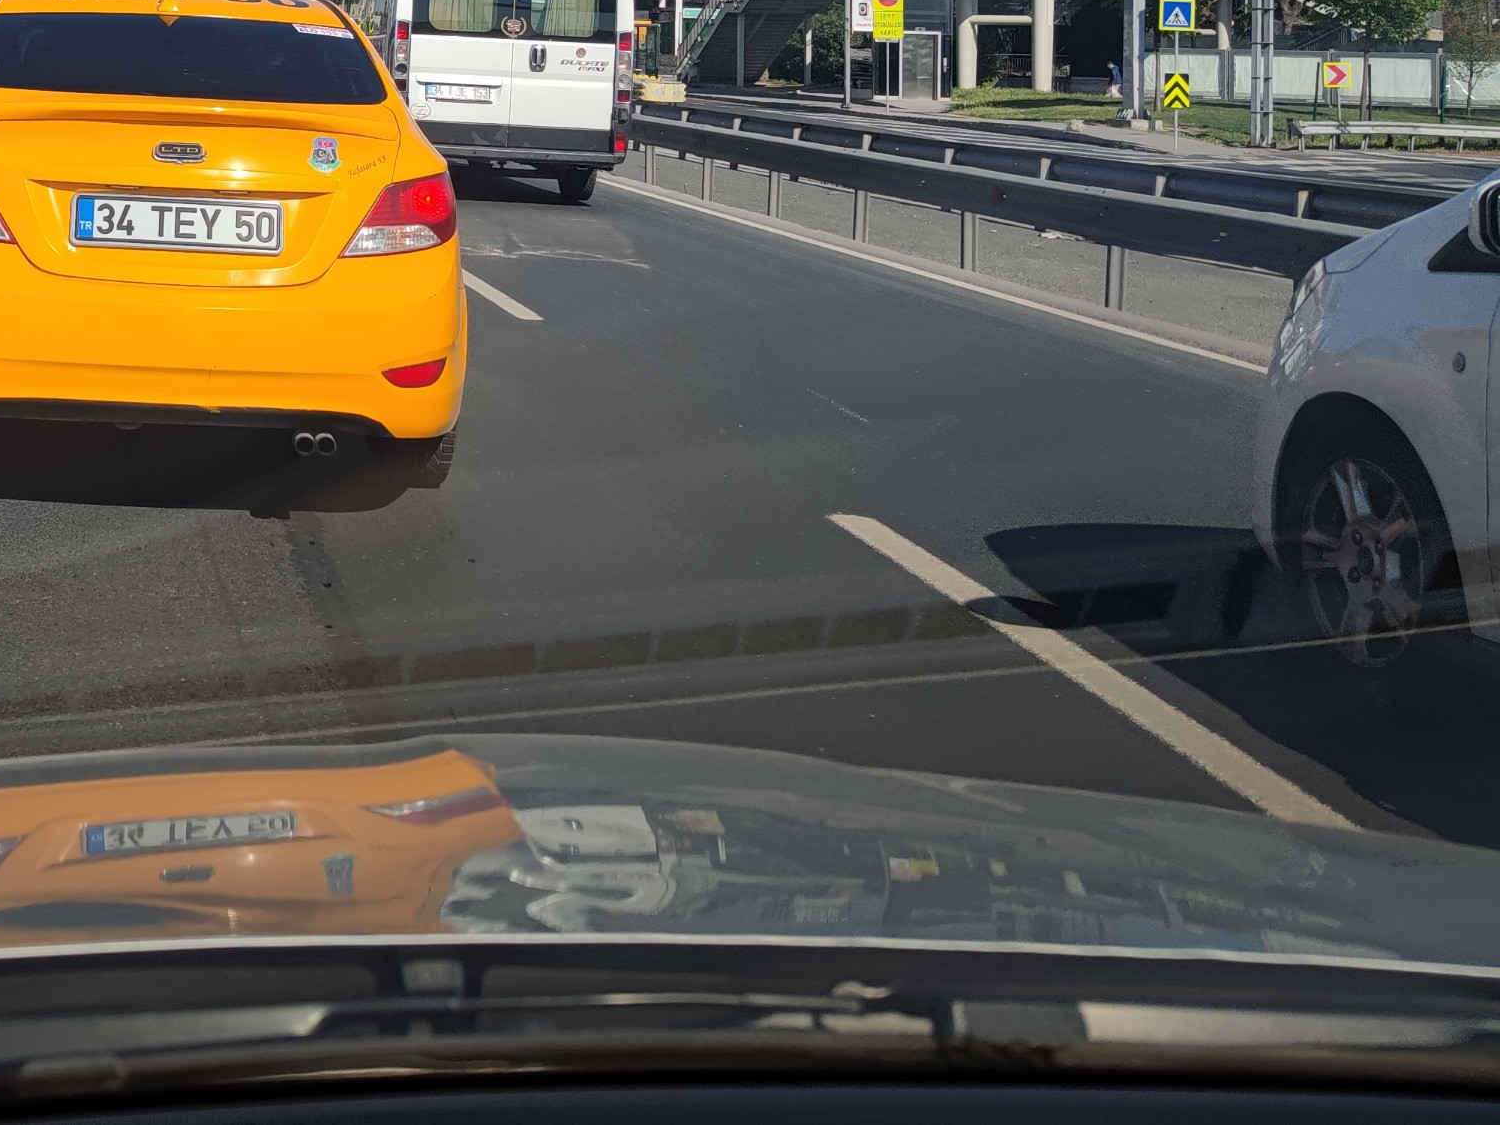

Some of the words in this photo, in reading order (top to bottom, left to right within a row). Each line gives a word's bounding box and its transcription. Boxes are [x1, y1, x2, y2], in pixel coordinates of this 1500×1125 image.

[79, 220, 92, 230] TR
[96, 203, 135, 236] 34
[150, 205, 222, 240] TEY
[235, 210, 275, 243] 50
